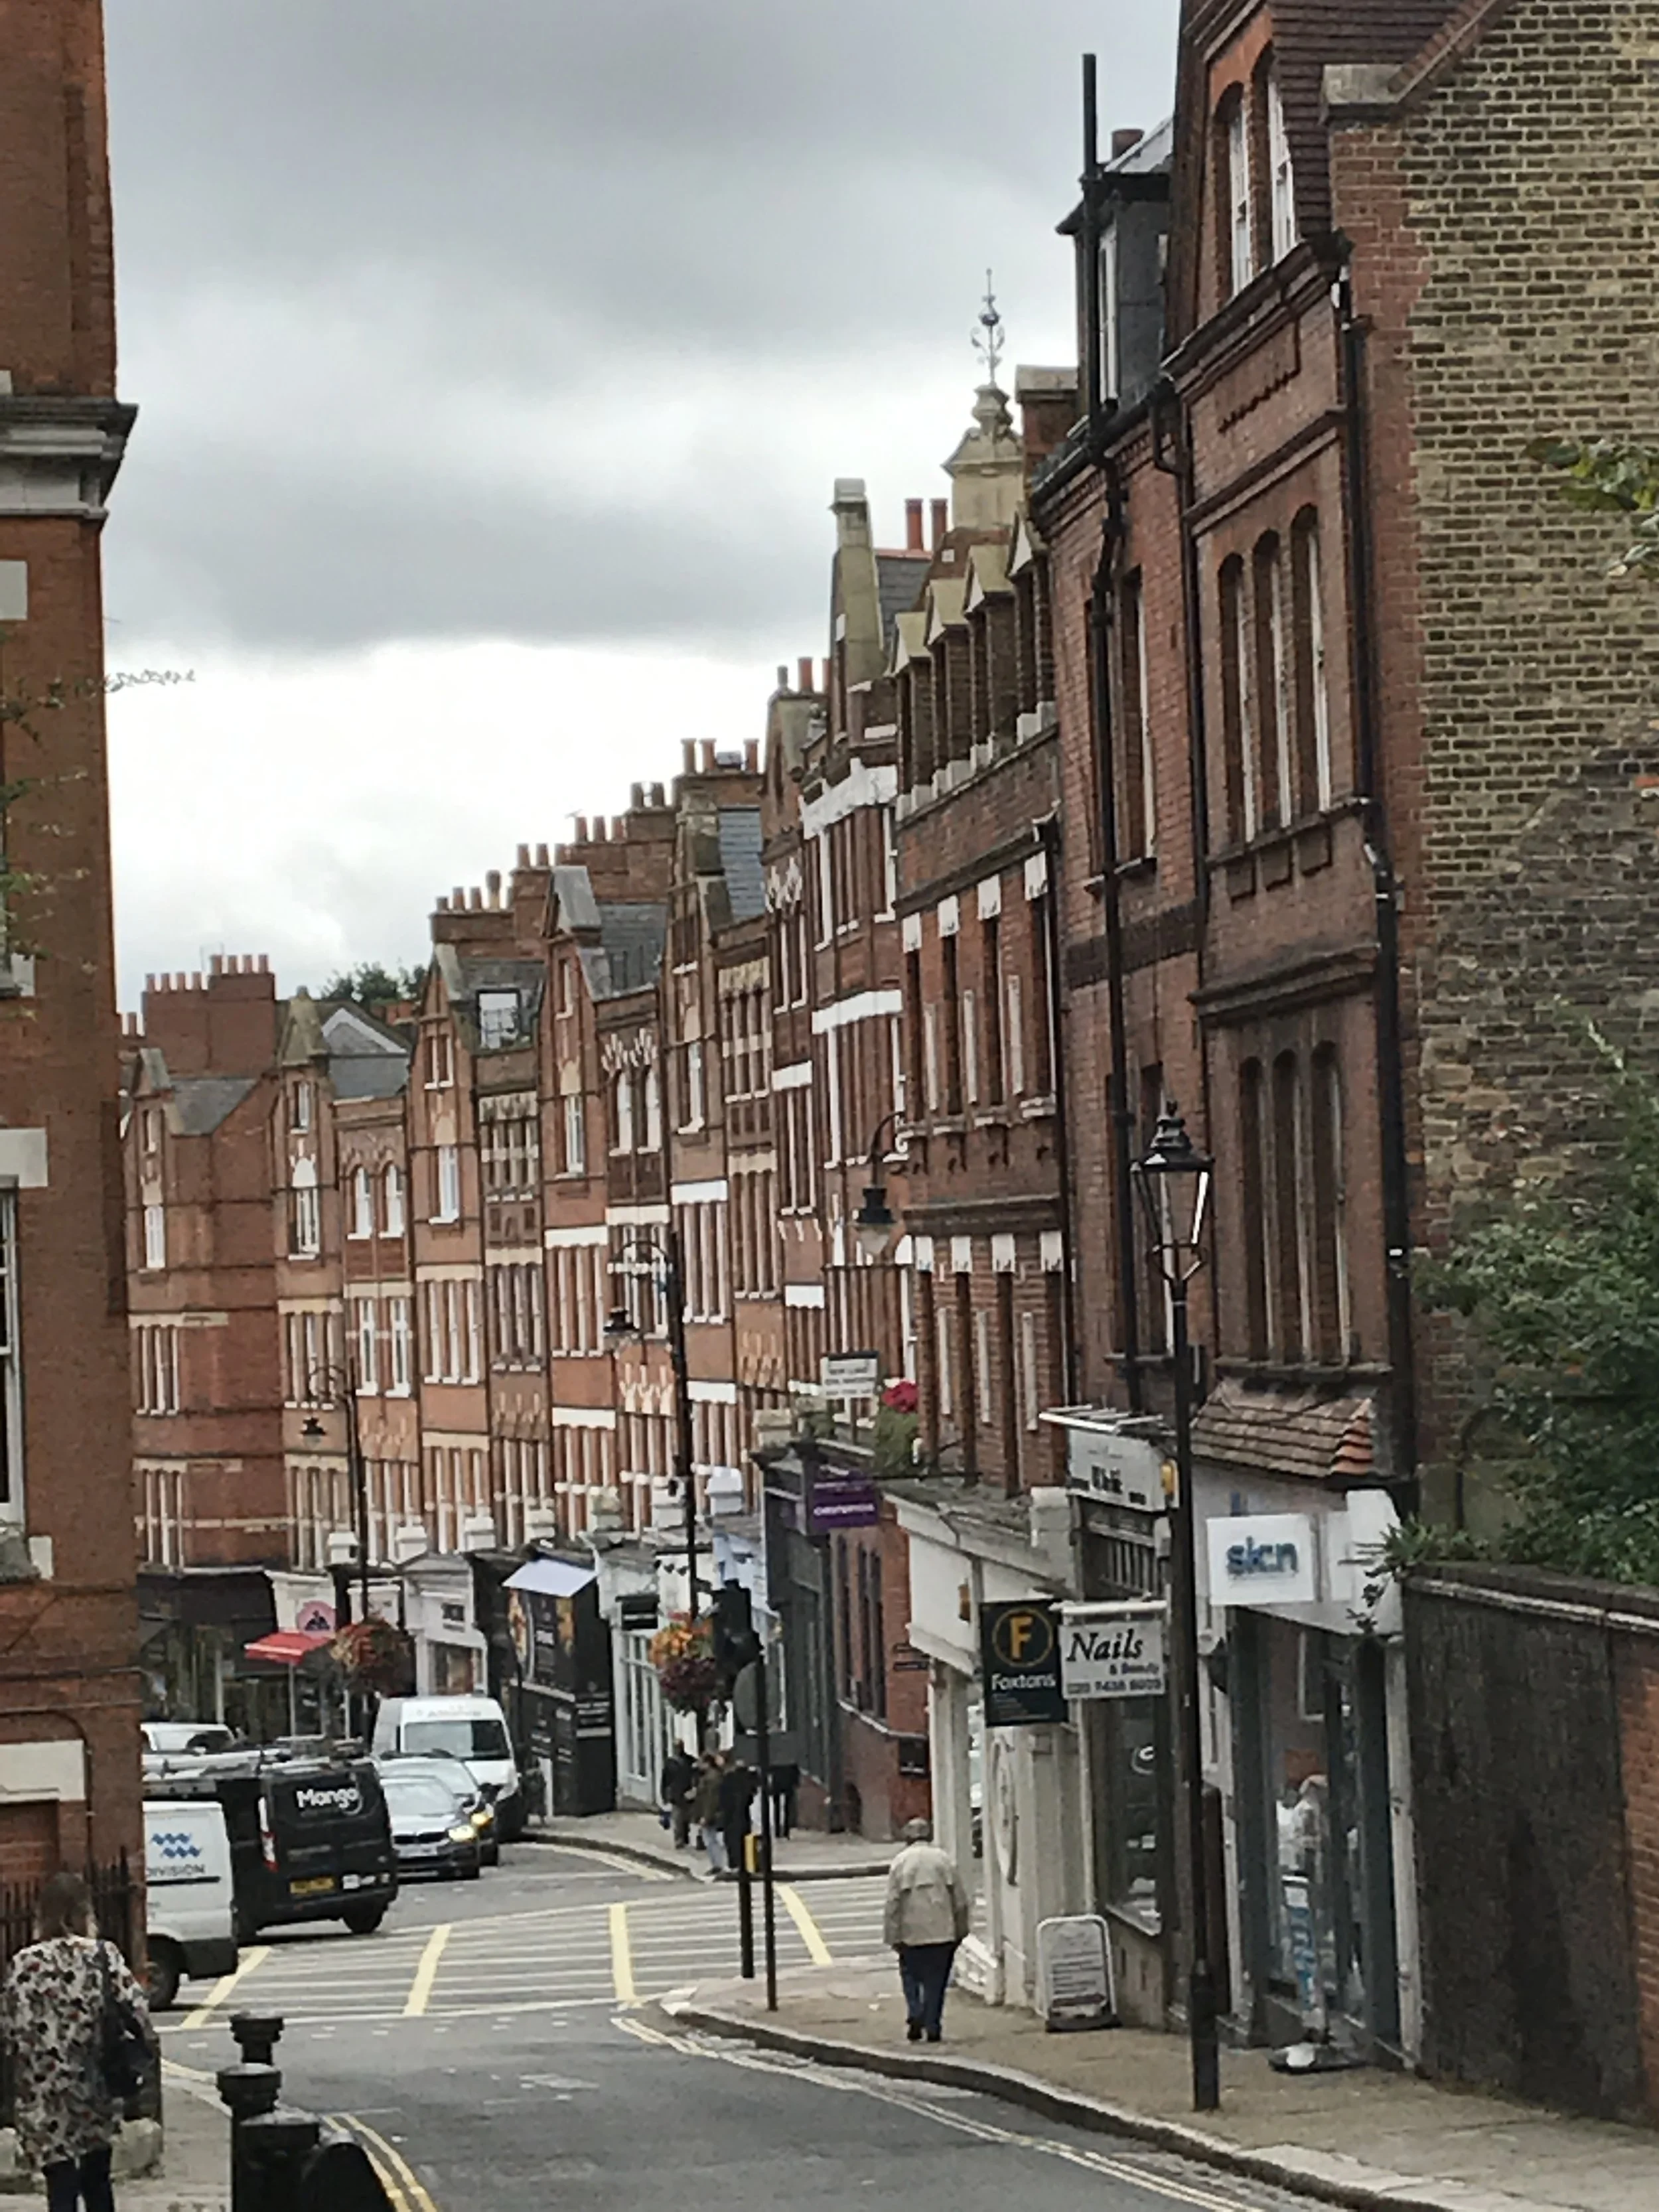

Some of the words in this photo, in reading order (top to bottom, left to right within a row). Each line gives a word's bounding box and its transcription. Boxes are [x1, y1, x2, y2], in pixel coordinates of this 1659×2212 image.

[1010, 1616, 1033, 1660] F
[1066, 1628, 1143, 1662] Nails
[991, 1672, 1057, 1690] Foxtons
[296, 1787, 360, 1809] Mango
